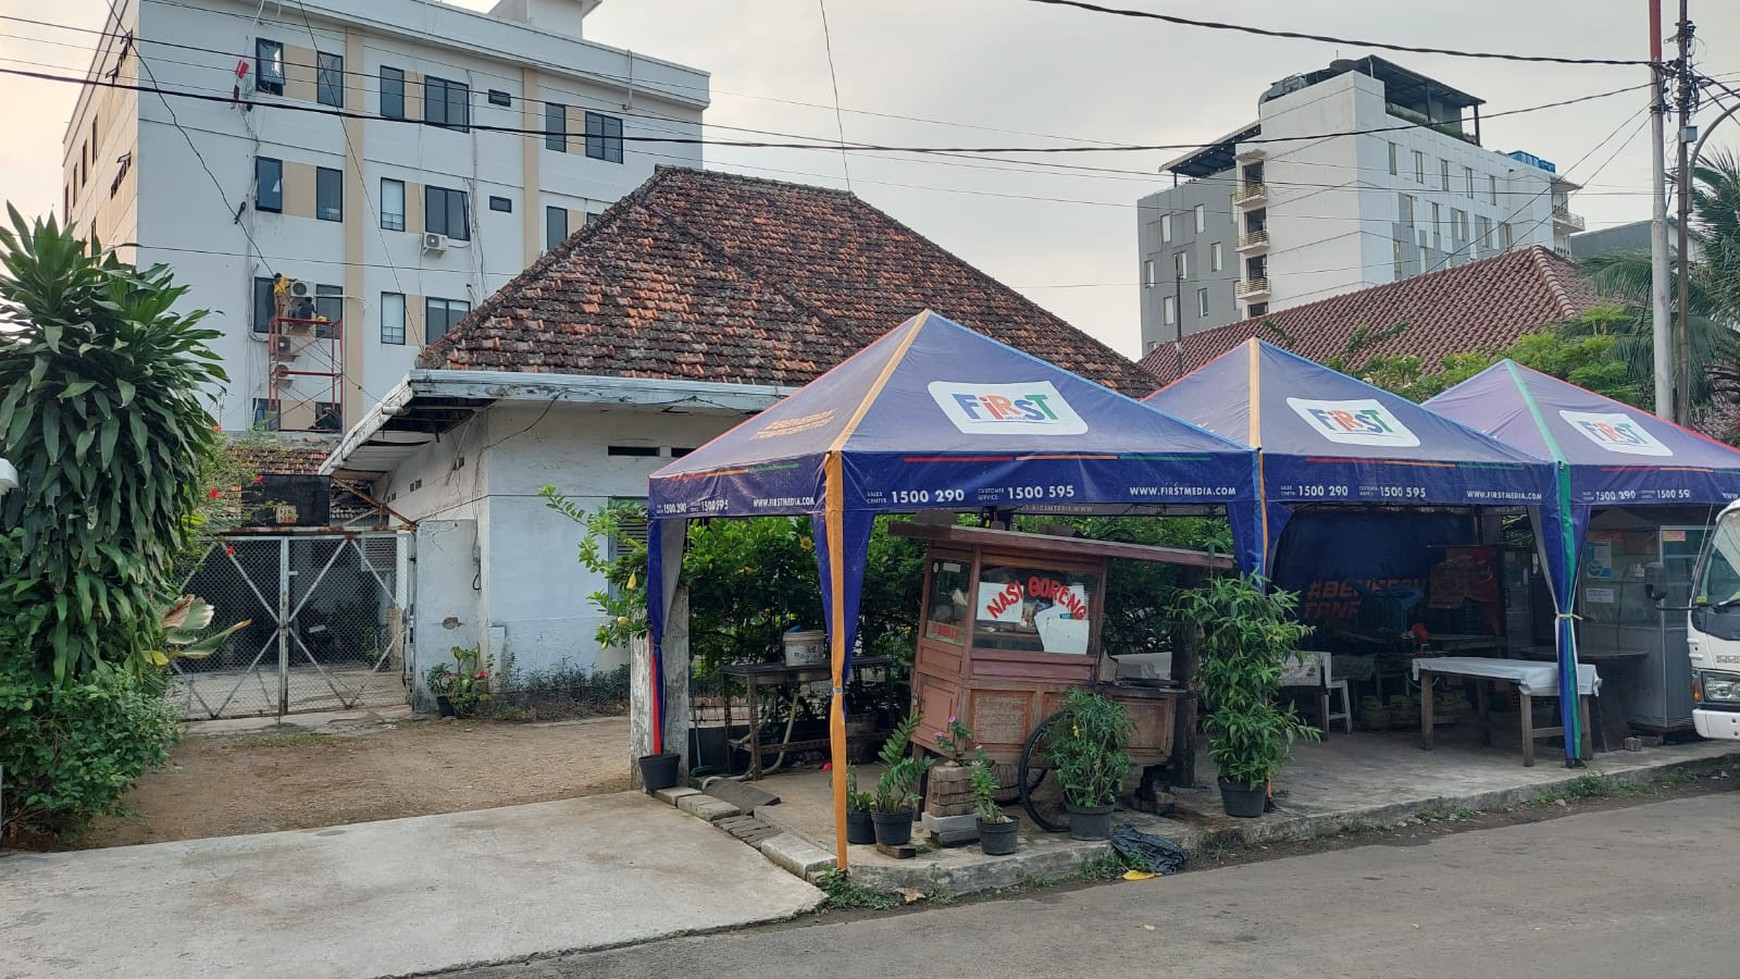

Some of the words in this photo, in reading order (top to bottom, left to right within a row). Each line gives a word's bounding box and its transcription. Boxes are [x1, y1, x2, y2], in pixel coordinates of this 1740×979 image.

[891, 490, 929, 504] 1500
[934, 489, 965, 502] 290
[1007, 486, 1044, 500] 1500
[1048, 485, 1075, 498] 595
[1129, 486, 1237, 496] WWW.FIRSTMEDIA.COM
[1298, 485, 1324, 497] 1500
[1328, 485, 1349, 497] 290
[1379, 486, 1403, 497] 1500
[1406, 487, 1426, 498] 595
[1466, 489, 1543, 500] WWW.FIRSTMEDIA.COM
[1595, 491, 1616, 501] 1500
[1618, 489, 1637, 500] 290
[1656, 489, 1676, 499] 1500
[986, 579, 1024, 619] NASI
[1027, 576, 1088, 620] GORENG
